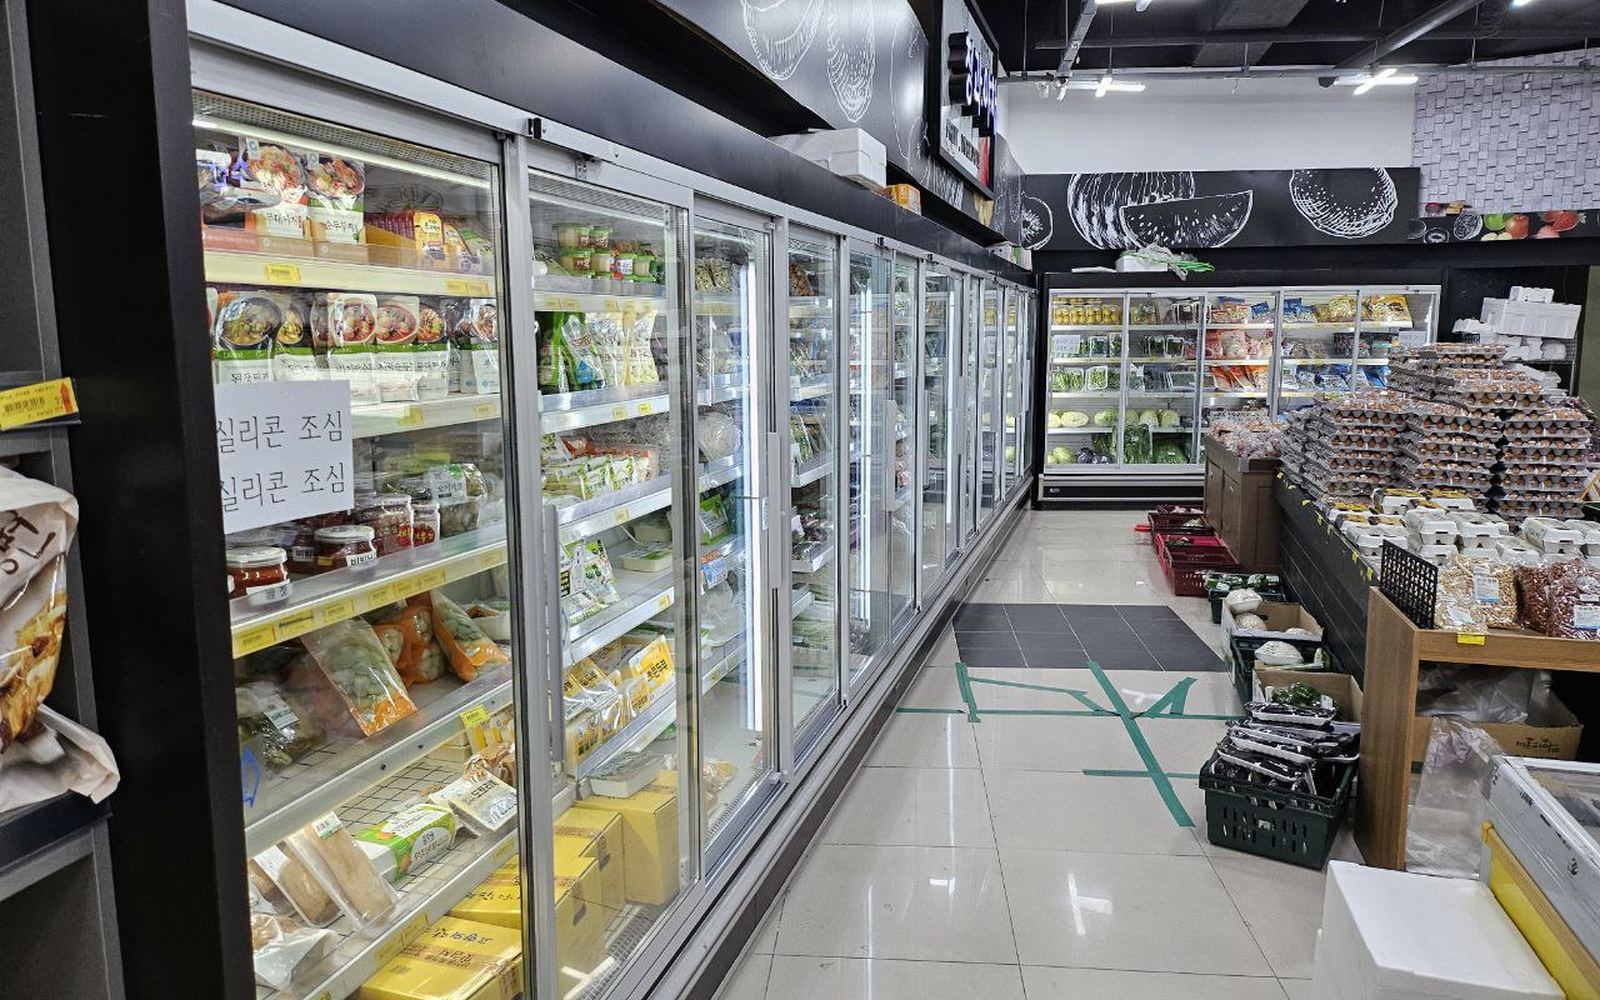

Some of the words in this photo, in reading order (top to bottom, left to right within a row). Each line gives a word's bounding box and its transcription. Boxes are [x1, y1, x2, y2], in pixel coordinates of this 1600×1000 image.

[217, 415, 285, 454] 실리콘
[299, 410, 343, 442] 조심
[220, 471, 288, 513] 실리콘
[302, 462, 345, 494] 조심
